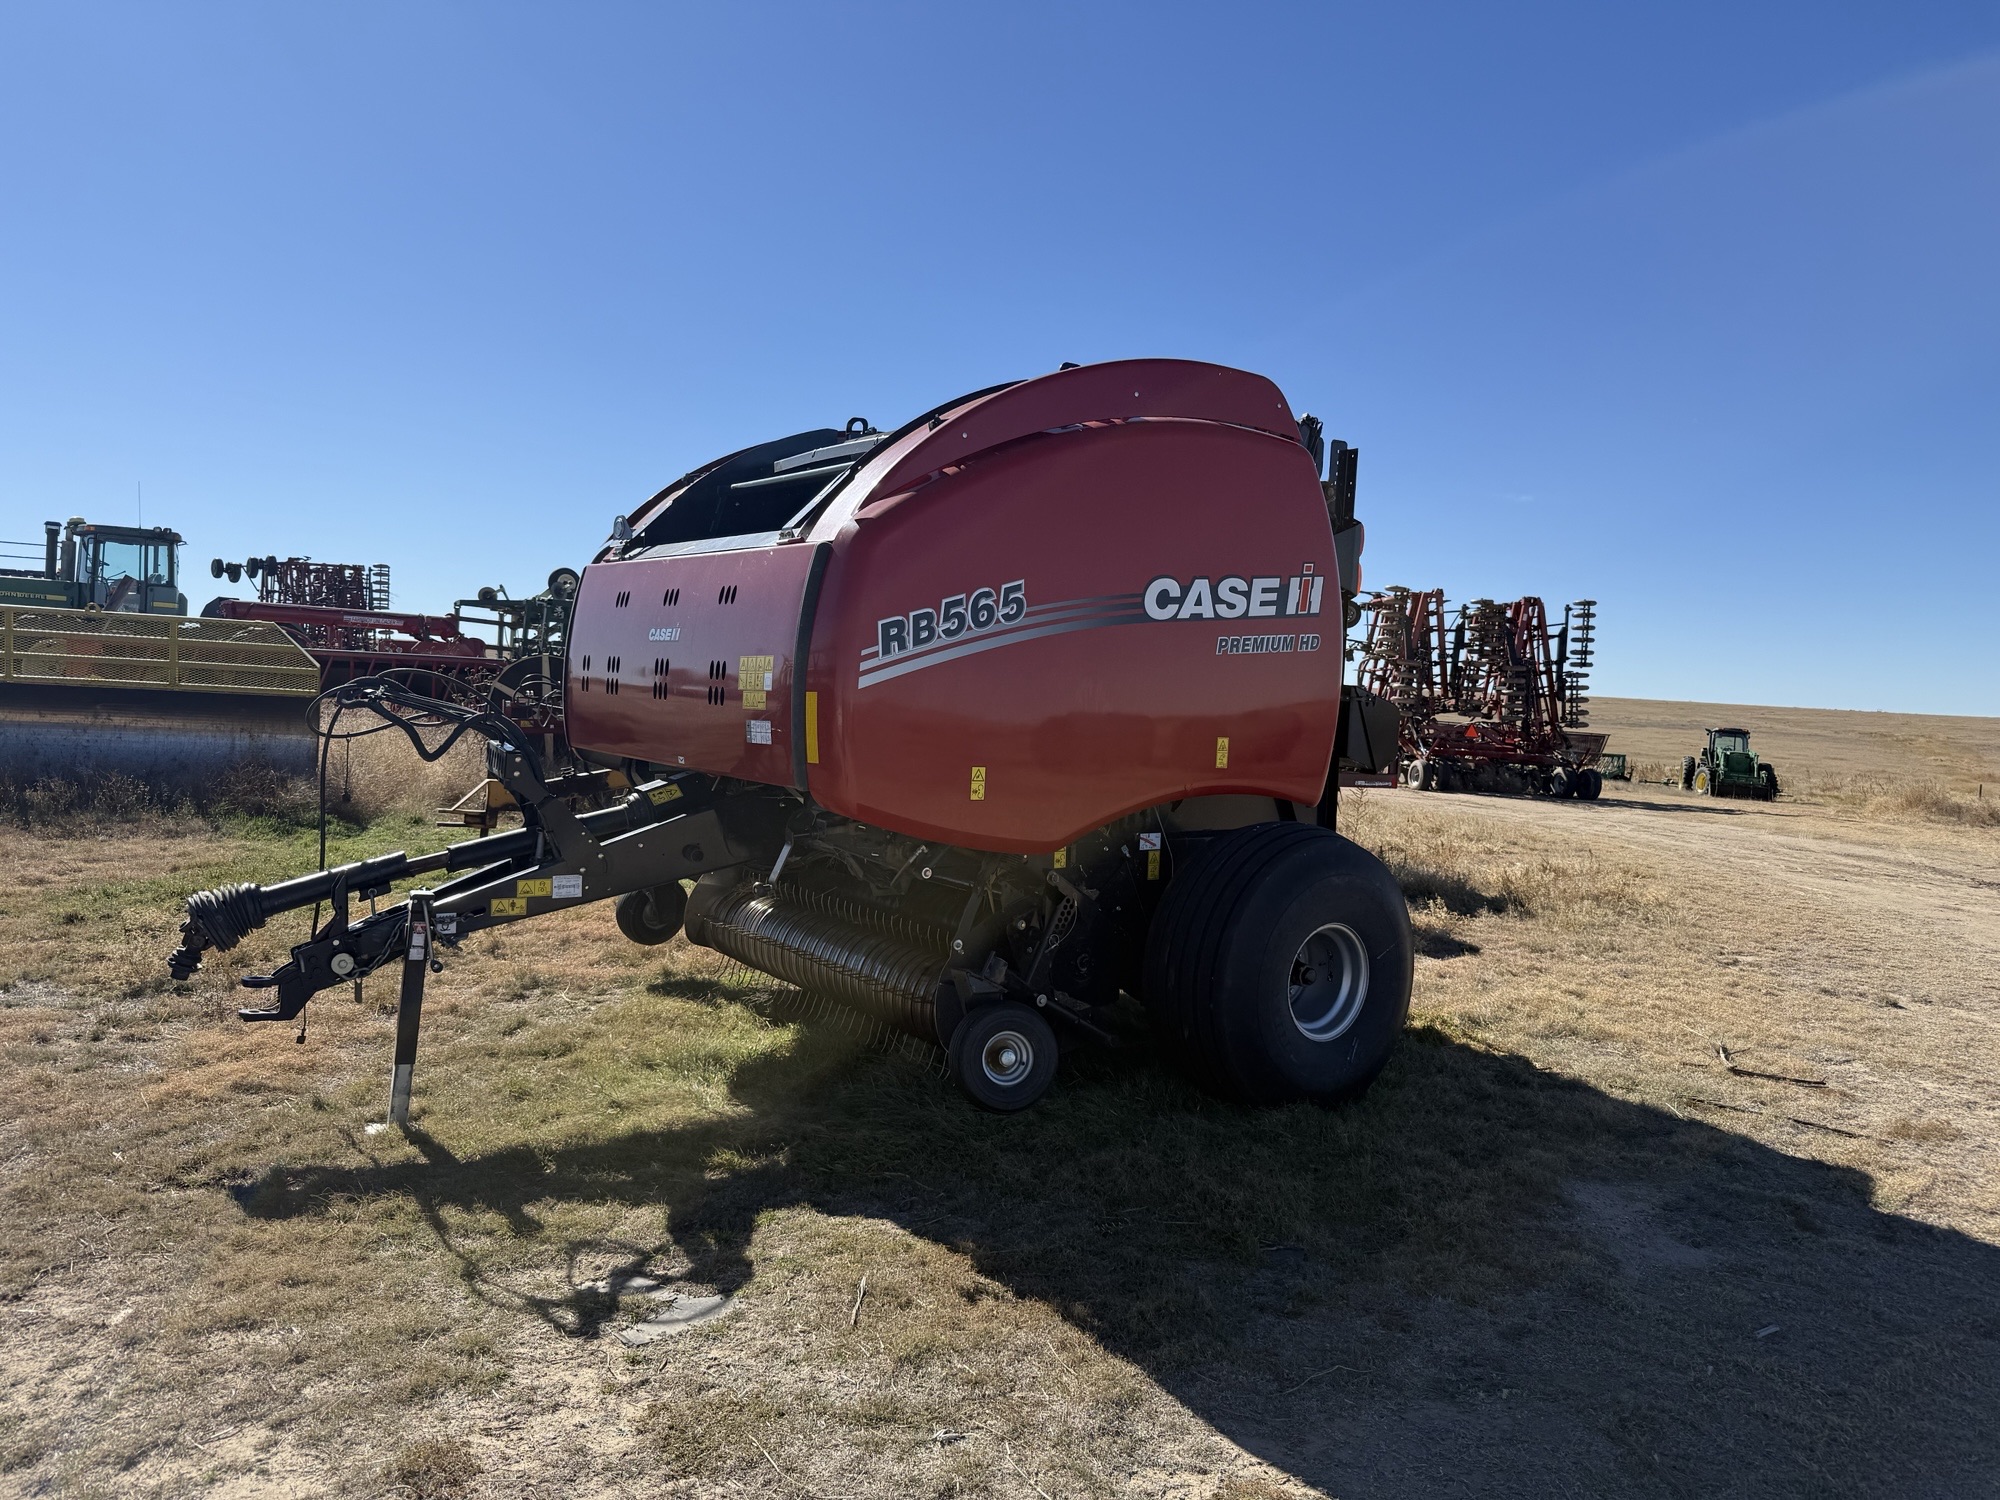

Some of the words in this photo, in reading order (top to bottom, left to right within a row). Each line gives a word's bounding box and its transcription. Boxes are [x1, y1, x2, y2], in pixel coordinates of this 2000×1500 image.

[1144, 577, 1281, 621] CASE
[648, 628, 672, 641] CASE
[877, 579, 1027, 660] RB565
[1216, 635, 1295, 655] PREMIUM
[1298, 634, 1321, 651] HD
